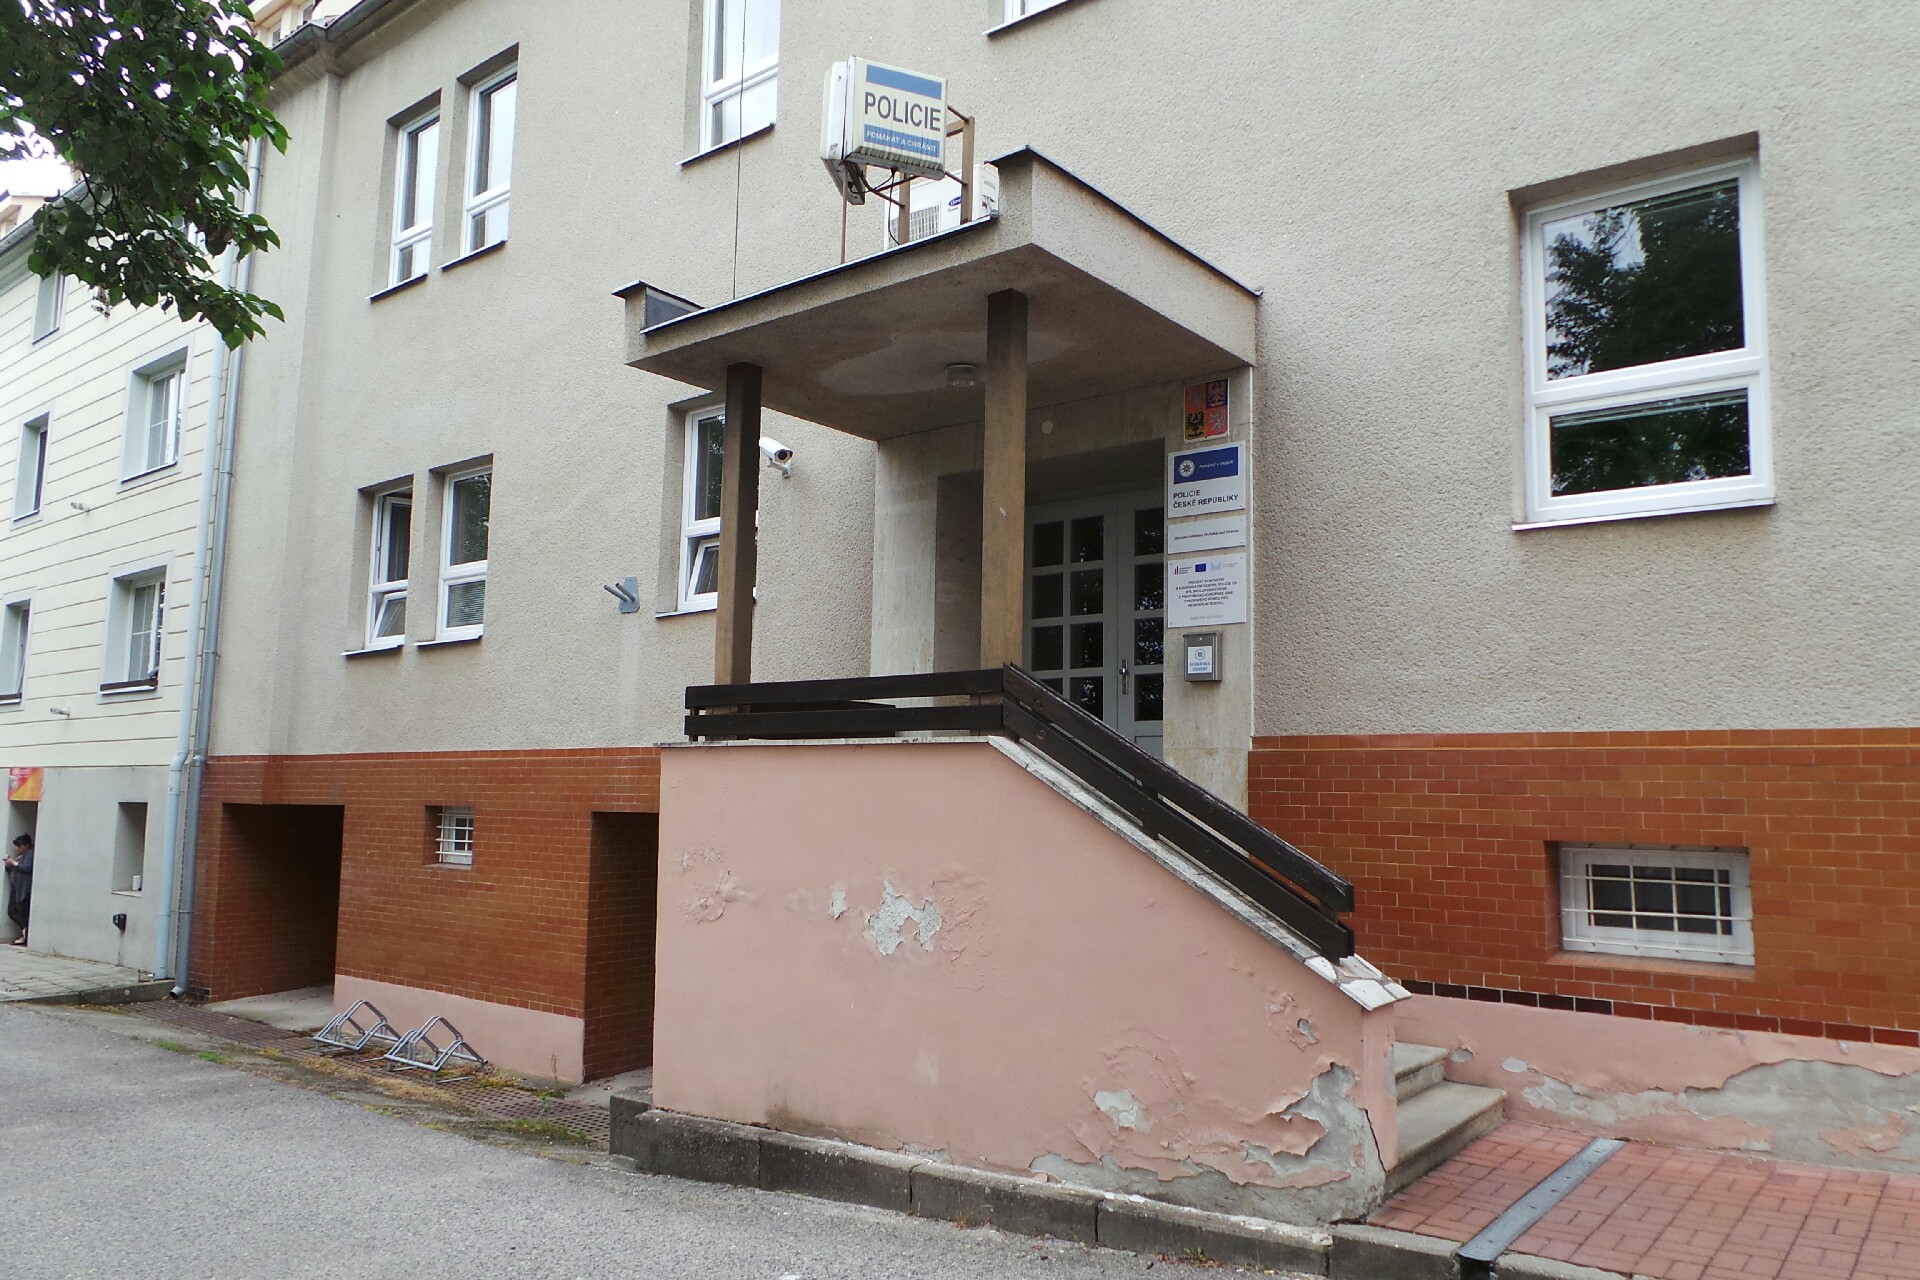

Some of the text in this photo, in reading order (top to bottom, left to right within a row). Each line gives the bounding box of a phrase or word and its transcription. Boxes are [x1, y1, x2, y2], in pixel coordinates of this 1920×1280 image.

[864, 91, 941, 132] POLICIE
[901, 138, 906, 146] A
[907, 139, 937, 152] CHRÁNIT
[1173, 489, 1201, 499] POLICIE
[1173, 494, 1239, 509] ČESKÉ REPUBLIKY
